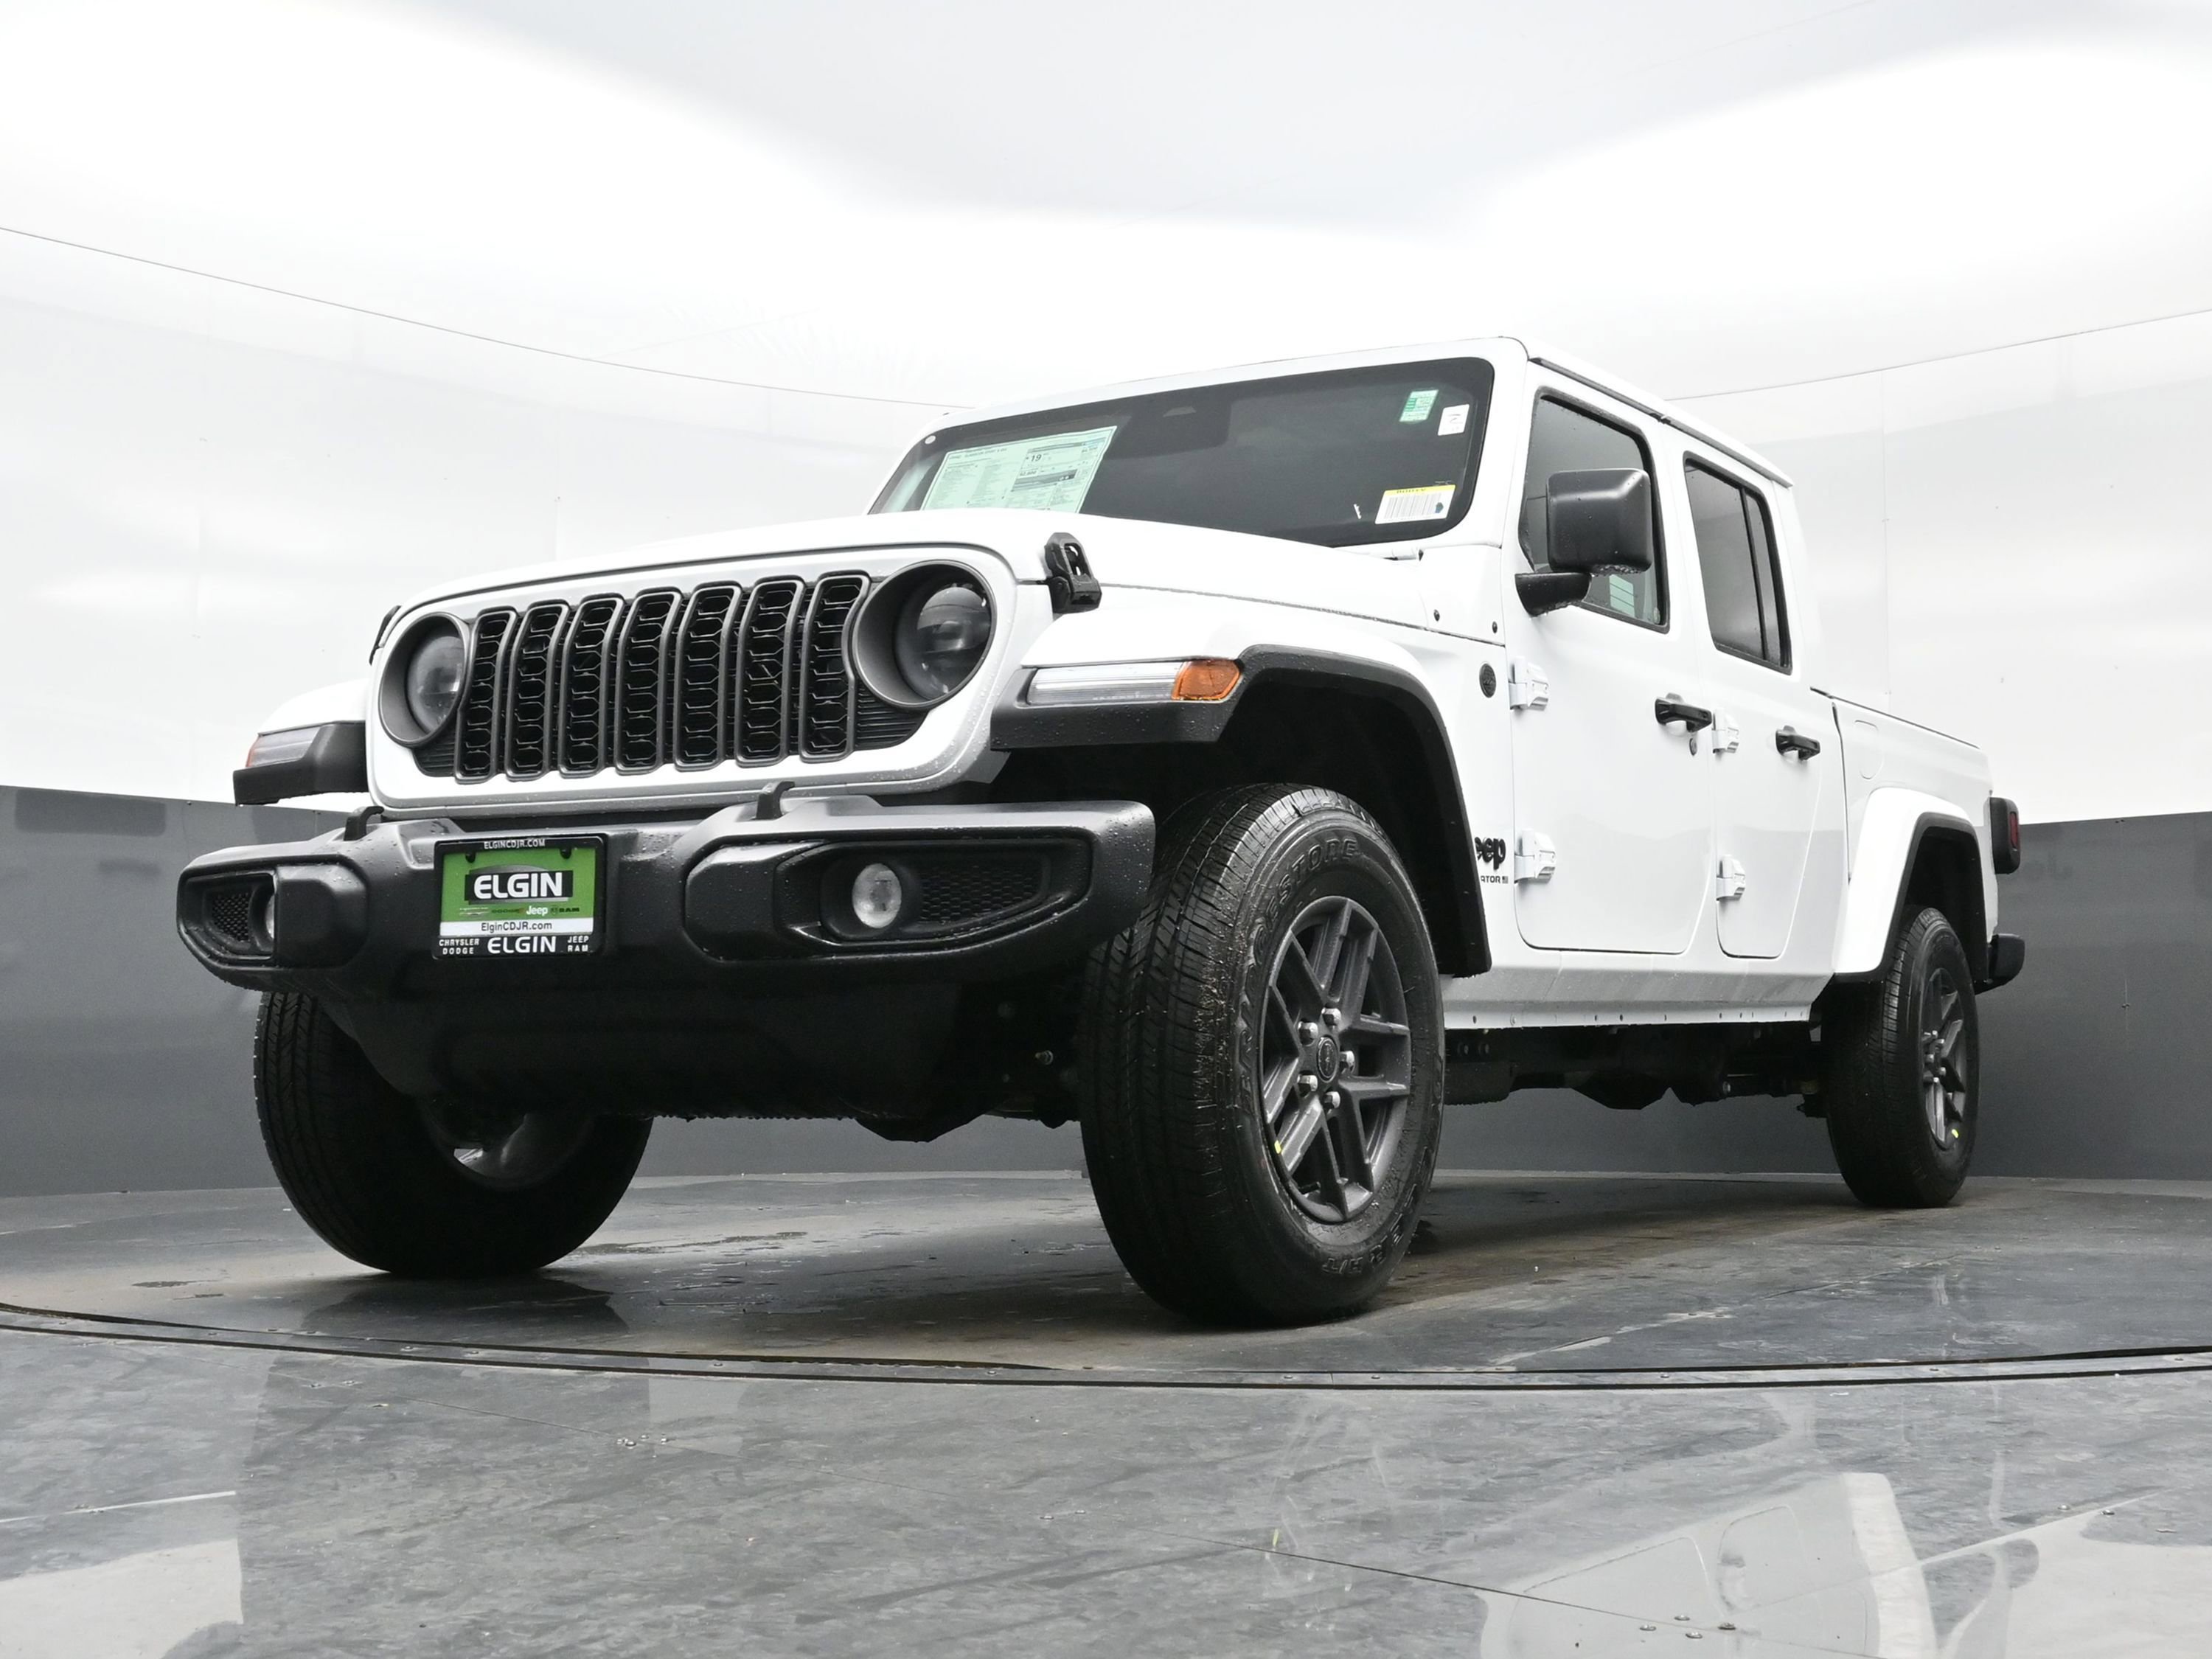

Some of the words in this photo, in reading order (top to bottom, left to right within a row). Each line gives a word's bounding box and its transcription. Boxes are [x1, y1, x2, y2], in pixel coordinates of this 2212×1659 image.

[484, 839, 546, 849] ELGINCDJR.COM
[1474, 836, 1506, 870] eep
[474, 872, 563, 900] ELGIN
[526, 905, 548, 917] Jeep
[481, 921, 552, 933] ElginCDJR.com
[439, 938, 479, 947] CHRYSLER
[487, 936, 557, 953] ELGIN
[567, 935, 589, 944] JEEP
[442, 947, 474, 955] DODGE
[567, 944, 588, 952] RAM
